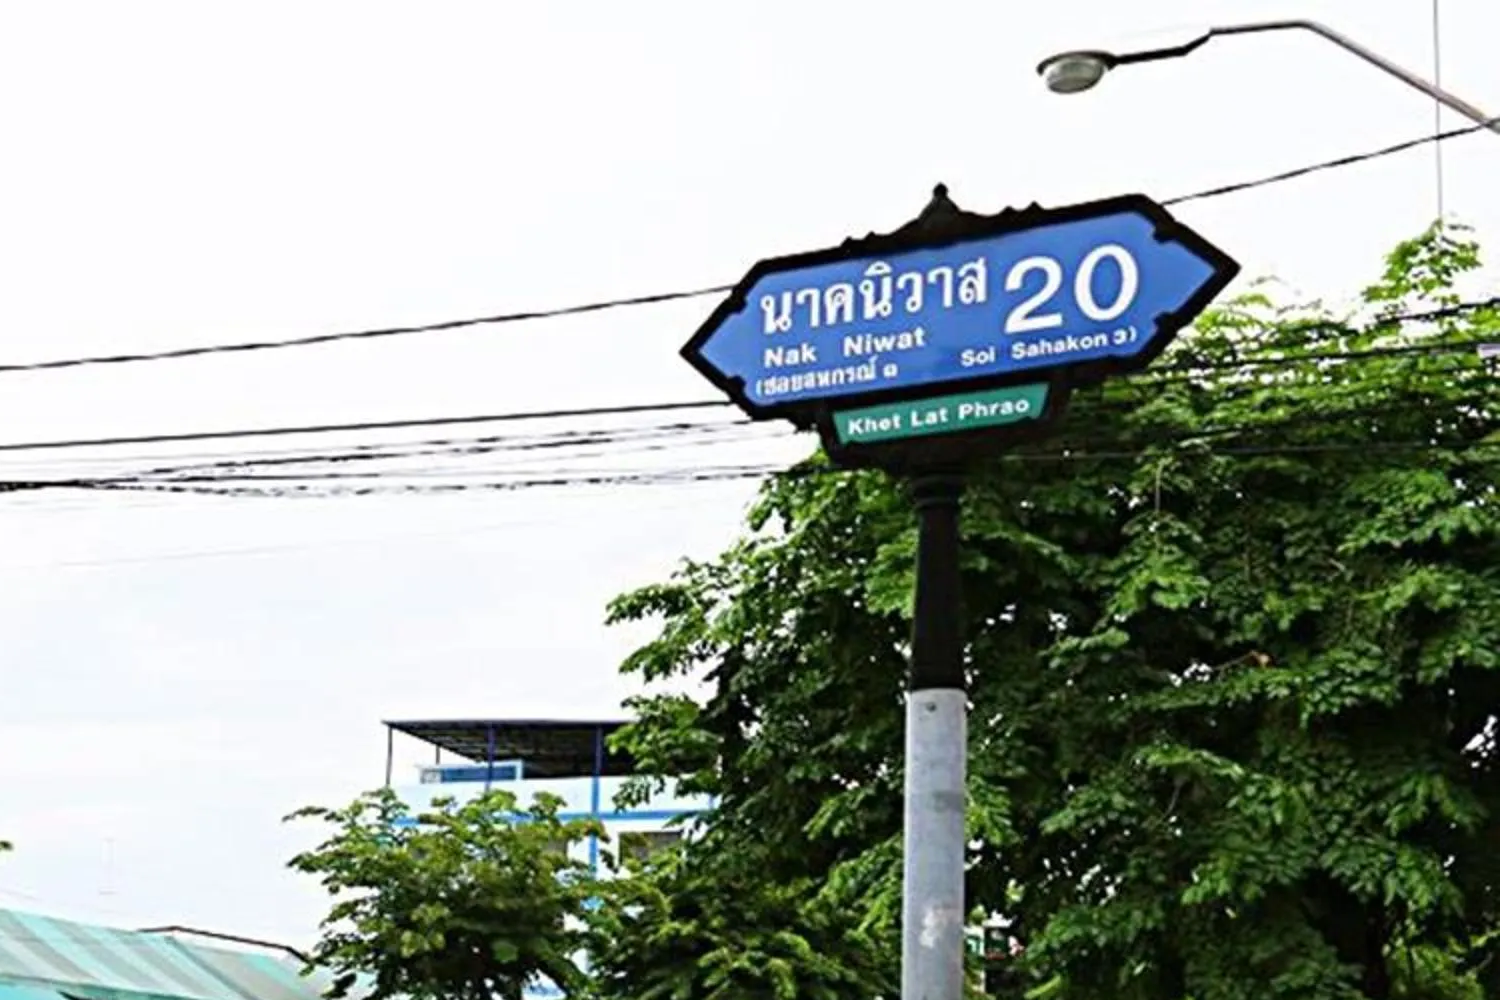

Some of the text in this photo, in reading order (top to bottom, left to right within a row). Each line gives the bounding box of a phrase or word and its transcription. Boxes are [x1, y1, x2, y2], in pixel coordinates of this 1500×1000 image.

[760, 244, 1139, 334] นาคนิวาส 20
[764, 326, 926, 368] Nak Niwat
[961, 347, 996, 367] Soi
[1011, 332, 1109, 360] Sahakon
[848, 399, 1030, 436] Khet Lat Phrao
